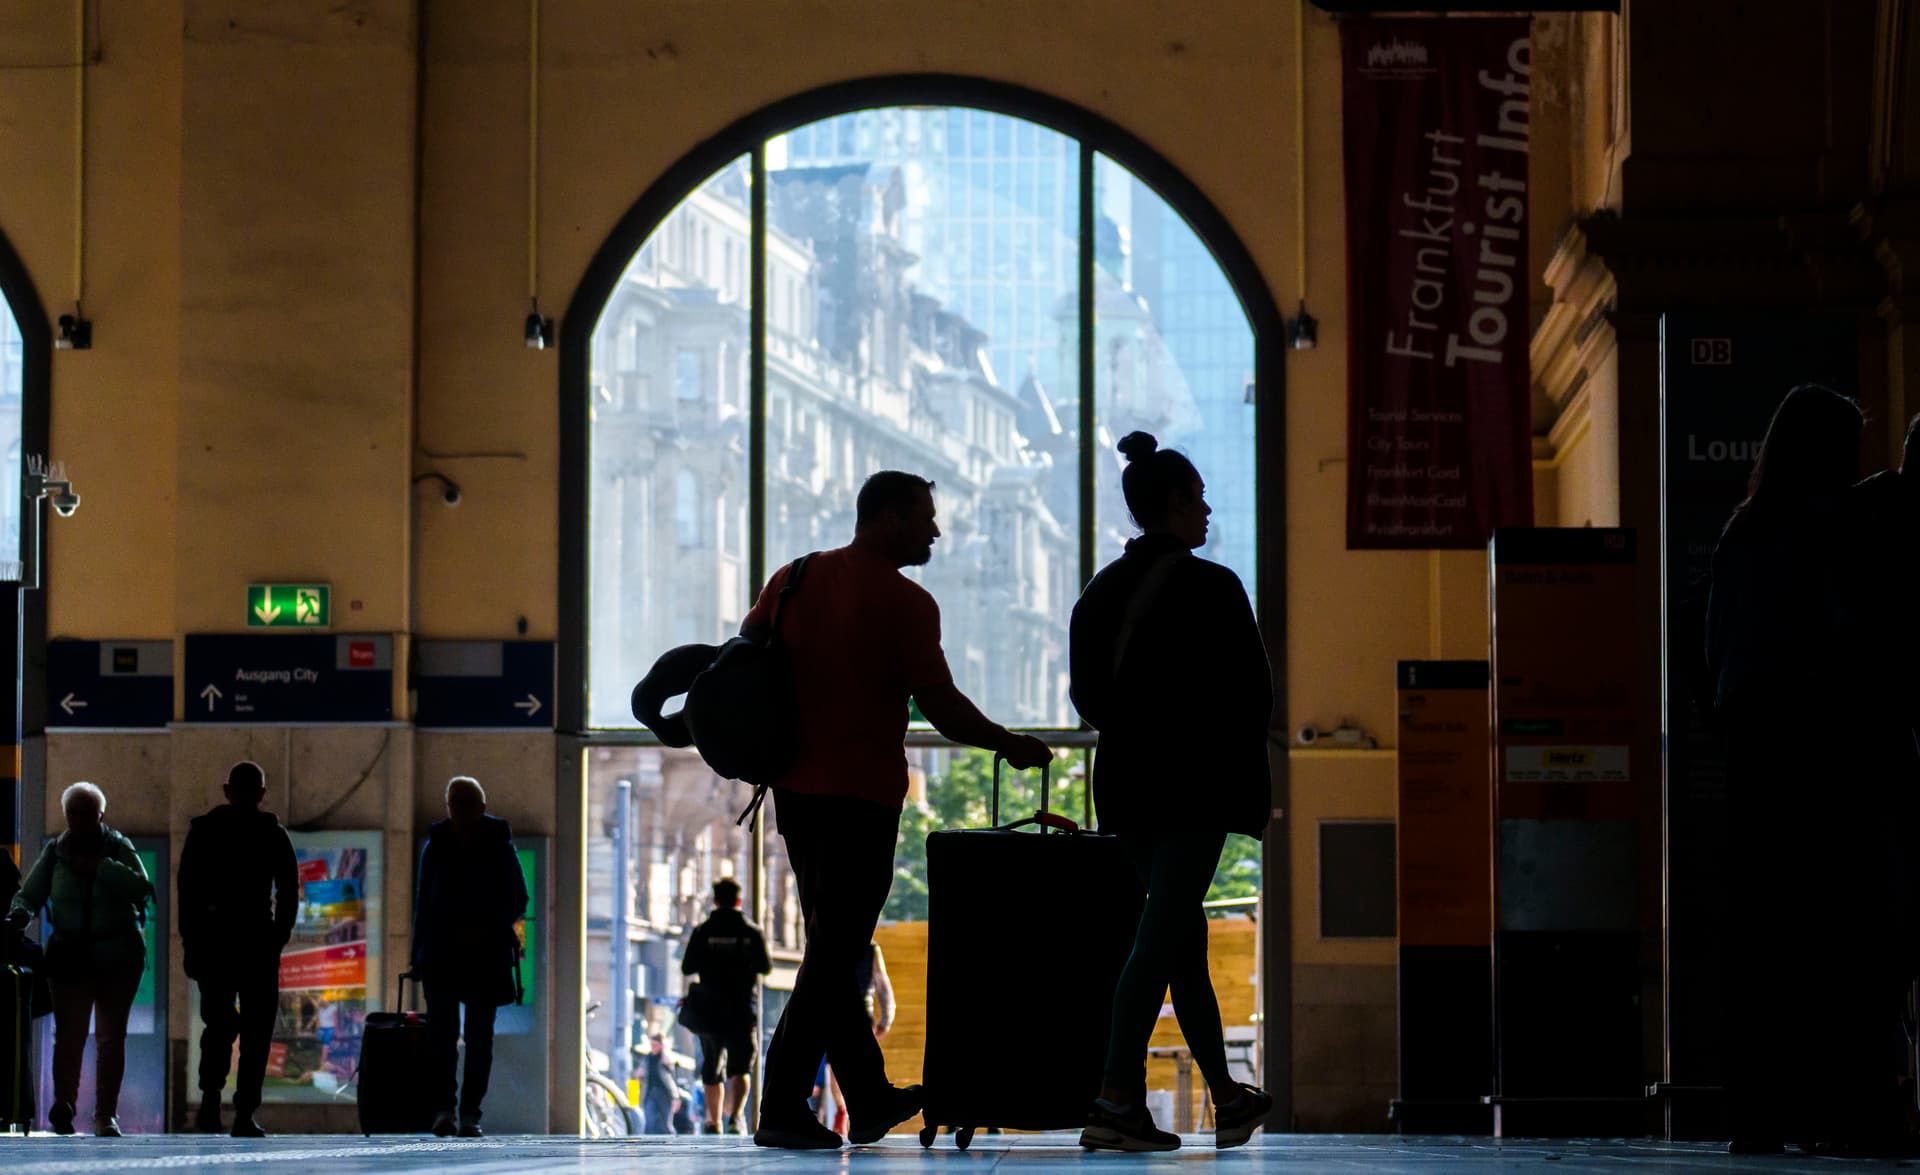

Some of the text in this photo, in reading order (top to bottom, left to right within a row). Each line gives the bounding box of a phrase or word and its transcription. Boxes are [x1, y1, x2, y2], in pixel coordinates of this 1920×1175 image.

[1444, 36, 1530, 368] Tourist Info
[1385, 128, 1465, 360] Frankfurt
[1694, 341, 1730, 362] DB
[1367, 435, 1393, 453] City
[235, 667, 319, 684] Ausgang City
